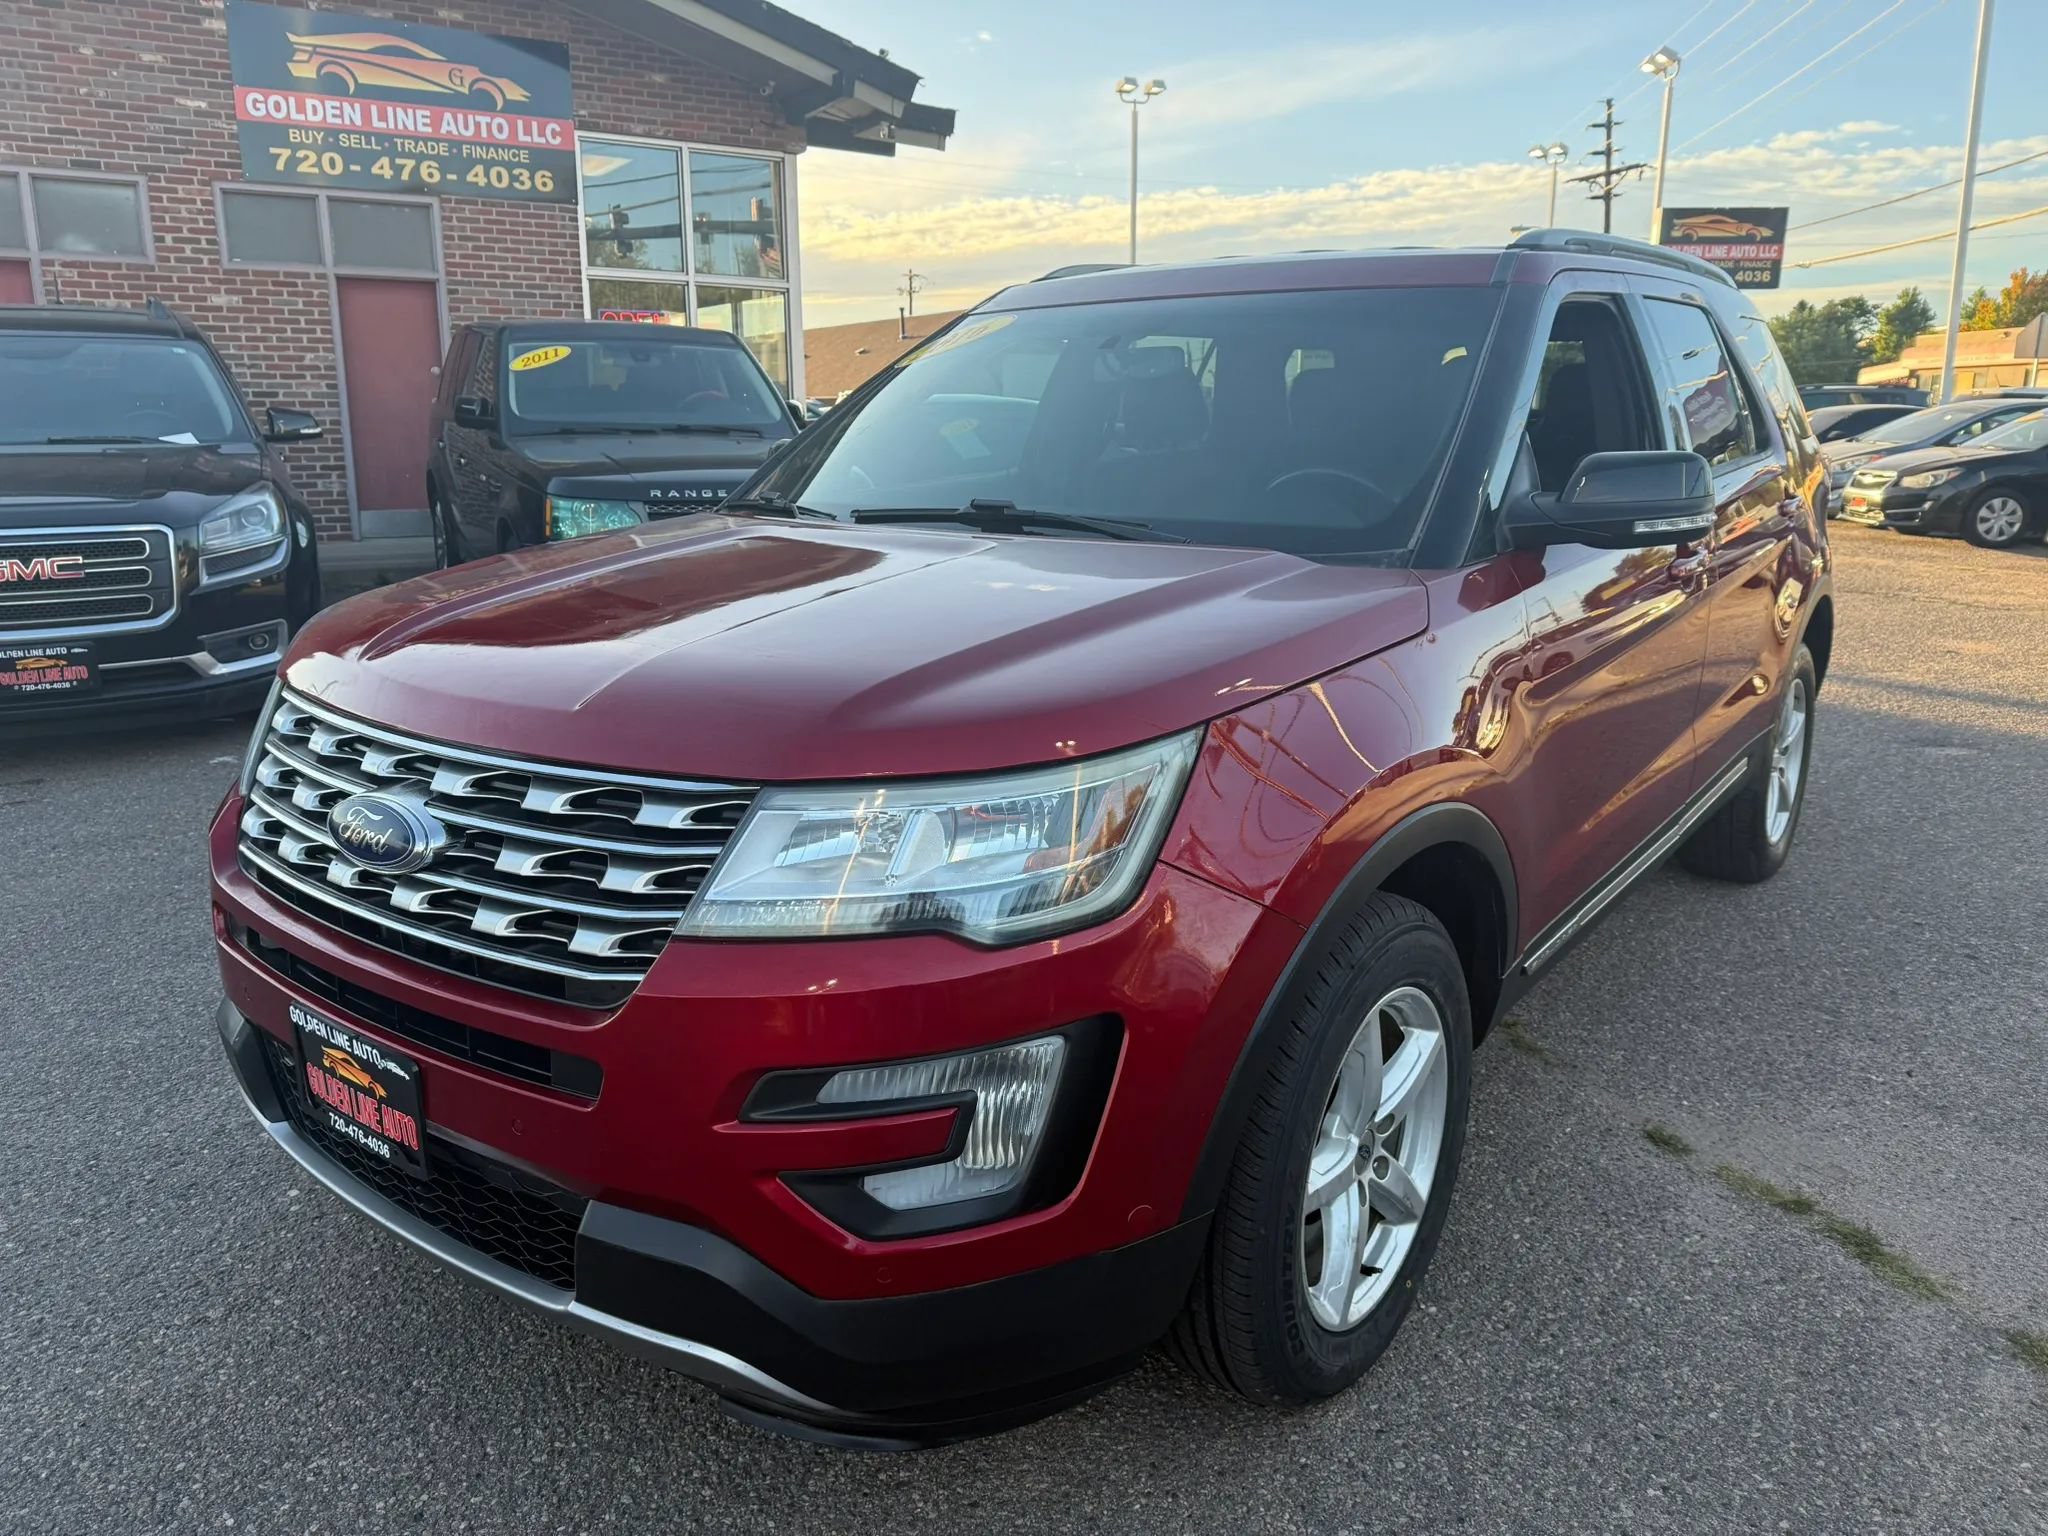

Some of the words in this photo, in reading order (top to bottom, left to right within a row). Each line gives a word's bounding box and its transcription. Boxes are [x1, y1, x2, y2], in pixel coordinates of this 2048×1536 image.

[245, 91, 362, 127] GOLDEN
[371, 104, 433, 134] LINE
[441, 112, 509, 141] AUTO
[516, 118, 562, 146] LLC
[288, 128, 325, 146] BUY
[338, 133, 382, 150] SELL
[394, 138, 449, 156] TRADE
[462, 143, 530, 163] FINANCE
[1704, 245, 1728, 258] LINE
[1730, 245, 1757, 258] AUTO
[1759, 245, 1778, 258] LLC
[1740, 260, 1772, 268] FINANCE
[1734, 270, 1771, 282] 4036
[521, 348, 561, 368] 2011
[650, 489, 728, 498] RANGE
[25, 648, 44, 657] LINE
[45, 646, 67, 656] AUTO
[39, 667, 62, 682] LINE
[63, 665, 89, 681] AUTO
[21, 681, 71, 691] 720-476-4036
[338, 806, 393, 855] Ford
[289, 1005, 328, 1041] GOLDEN
[328, 1026, 351, 1052] LINE
[353, 1039, 381, 1066] AUTO
[306, 1062, 353, 1117] GOLDEN
[350, 1088, 382, 1133] LINE
[381, 1104, 419, 1151] AUTO
[329, 1111, 390, 1159] 720-476-4036
